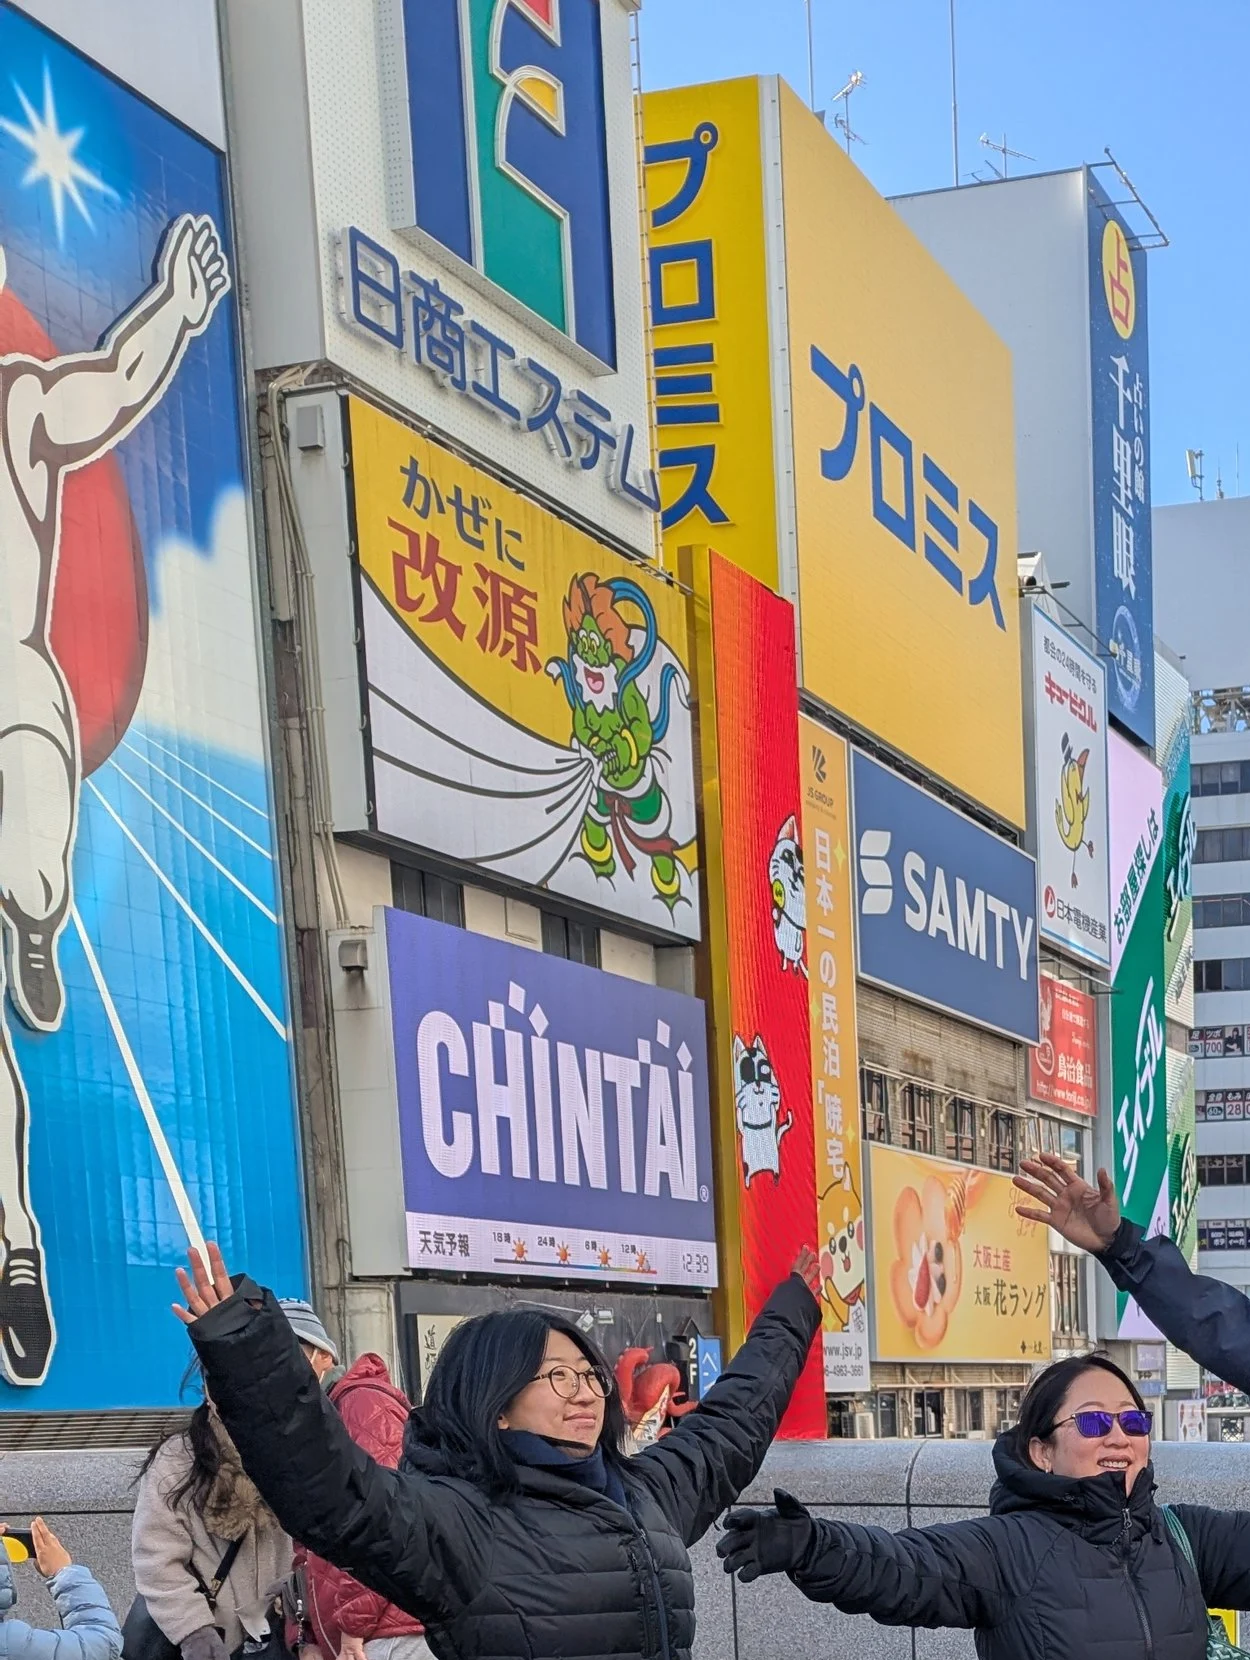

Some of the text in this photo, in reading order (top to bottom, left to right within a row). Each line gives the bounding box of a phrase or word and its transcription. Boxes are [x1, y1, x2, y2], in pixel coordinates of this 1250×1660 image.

[345, 226, 661, 513] 日商エステム
[644, 121, 733, 532] プロミス
[399, 455, 526, 572] かぜに
[810, 343, 1006, 633] プロミス
[1109, 354, 1136, 601] 千里眼
[387, 516, 542, 674] 改源
[903, 850, 1034, 981] SAMTY
[416, 983, 700, 1202] CHINTAI
[418, 1229, 470, 1257] 天気予報
[972, 1243, 1012, 1272] 大阪土産
[973, 1278, 1047, 1319] 大阪花ラング
[688, 1336, 698, 1385] 2F
